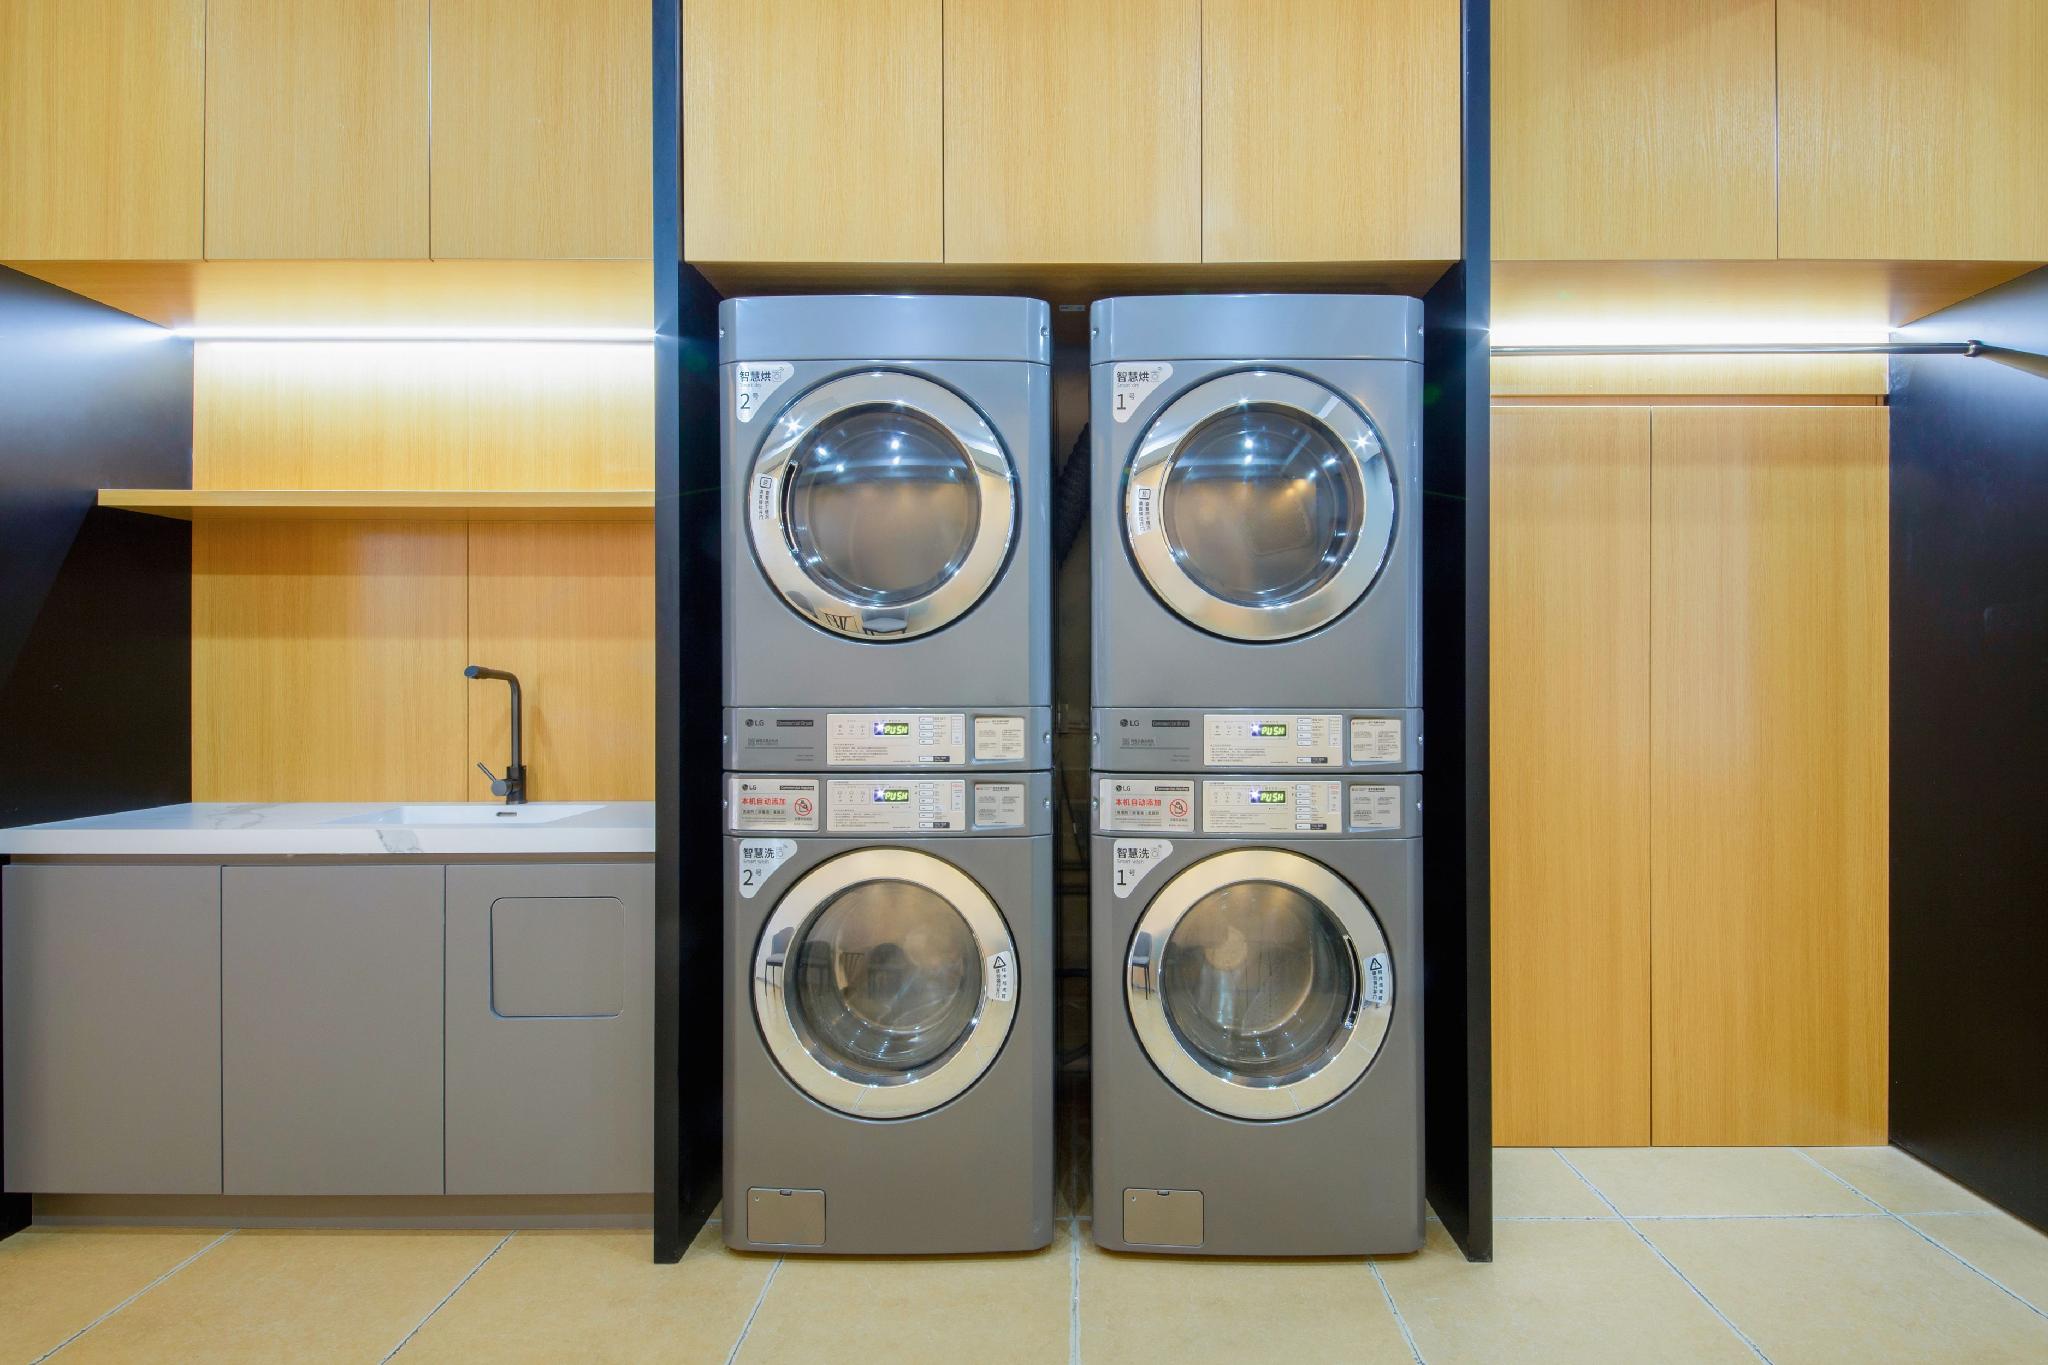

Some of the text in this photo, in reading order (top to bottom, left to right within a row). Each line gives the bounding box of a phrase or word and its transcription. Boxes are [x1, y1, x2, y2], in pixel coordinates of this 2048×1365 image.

[739, 370, 772, 382] 智慧烘
[1116, 371, 1150, 383] 智慧烘
[884, 725, 908, 735] PUSH
[1260, 726, 1285, 736] PUSH
[884, 791, 908, 801] PUSH
[1260, 792, 1284, 802] PUSH
[743, 847, 775, 859] 智慧洗
[1116, 847, 1150, 859] 智慧洗
